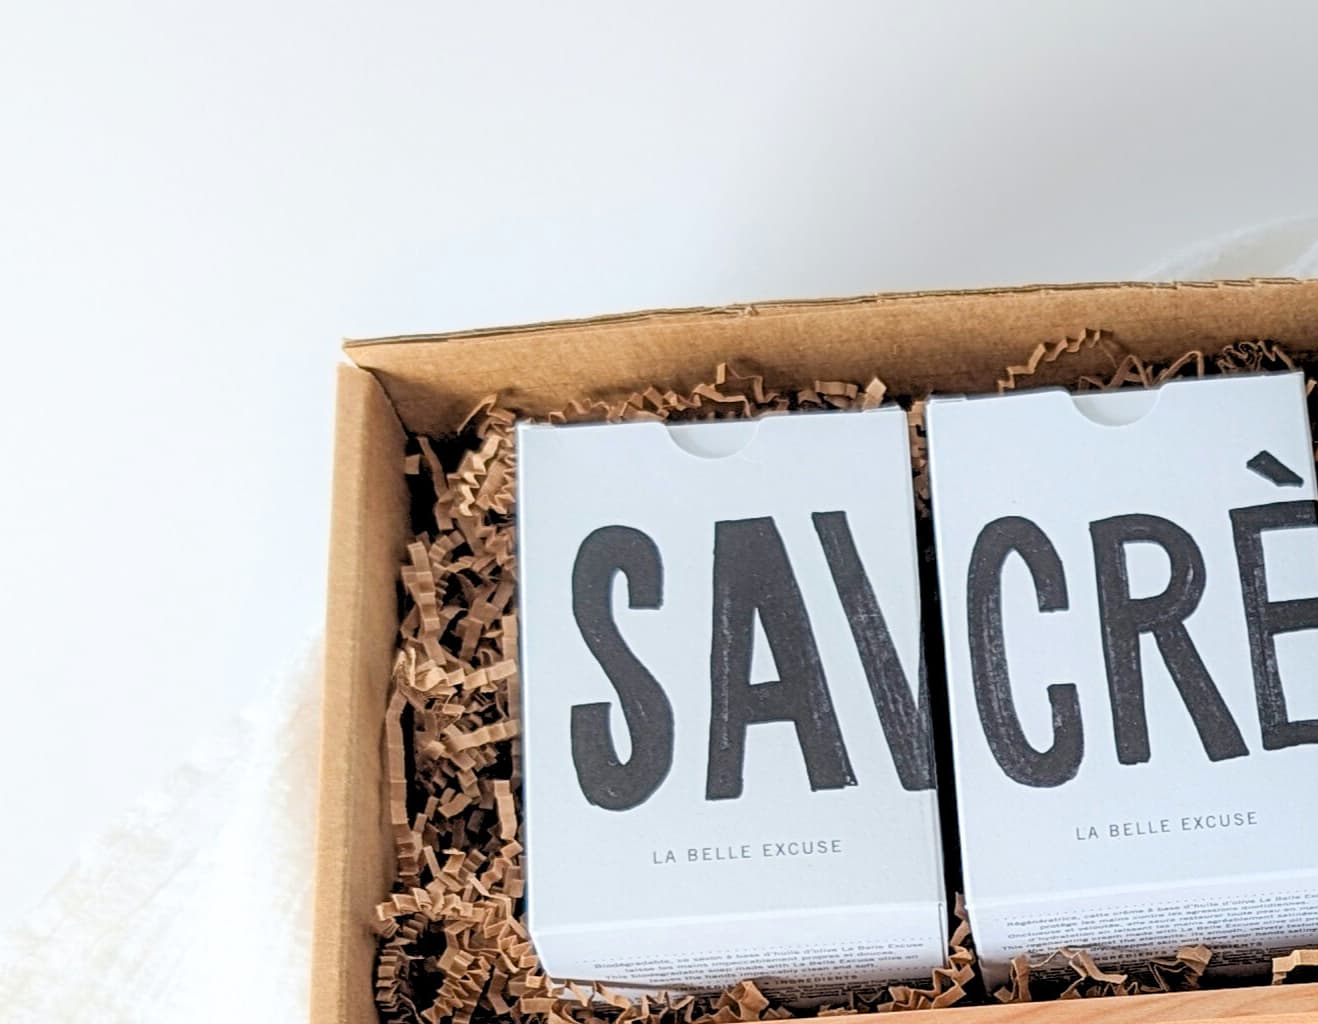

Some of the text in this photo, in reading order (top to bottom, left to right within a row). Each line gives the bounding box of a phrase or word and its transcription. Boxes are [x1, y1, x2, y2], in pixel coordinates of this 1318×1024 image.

[571, 511, 936, 811] SAV
[1076, 811, 1258, 841] LA BELLE EXCUSE
[653, 840, 842, 864] LA BELLE EXCUSE
